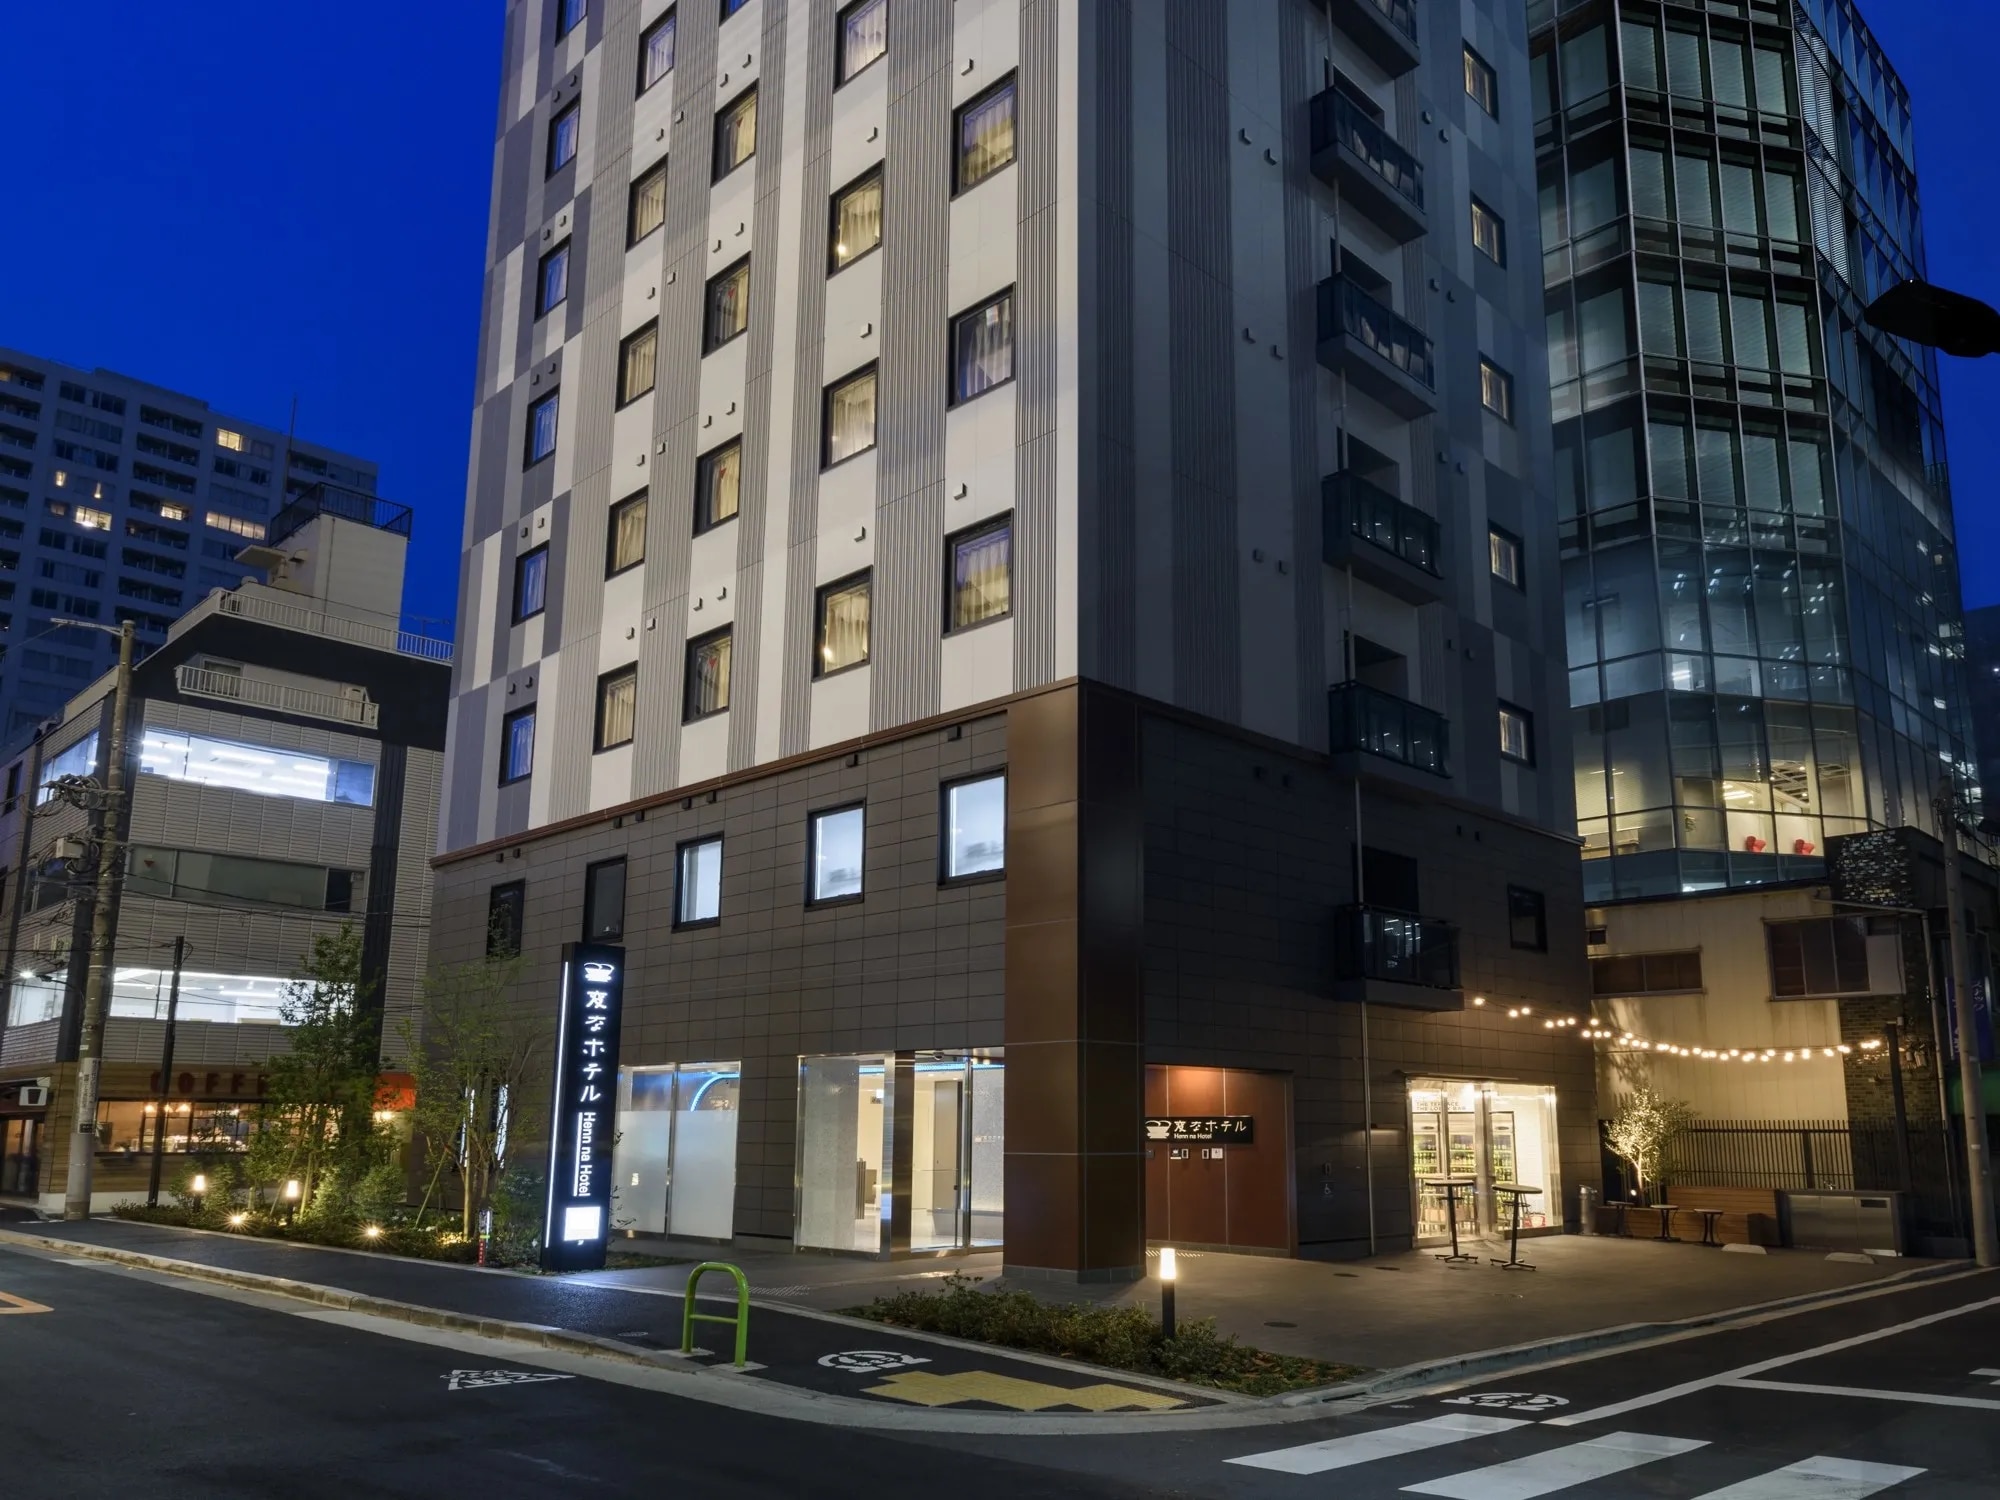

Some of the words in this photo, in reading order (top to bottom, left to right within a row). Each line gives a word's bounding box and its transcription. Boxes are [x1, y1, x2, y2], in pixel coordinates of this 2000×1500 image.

[579, 989, 608, 1102] 変なホテル
[150, 1071, 271, 1095] COFFE
[581, 1112, 596, 1144] Henn
[1173, 1120, 1247, 1133] 変なホテル
[580, 1146, 591, 1162] na
[578, 1164, 593, 1197] Hotel
